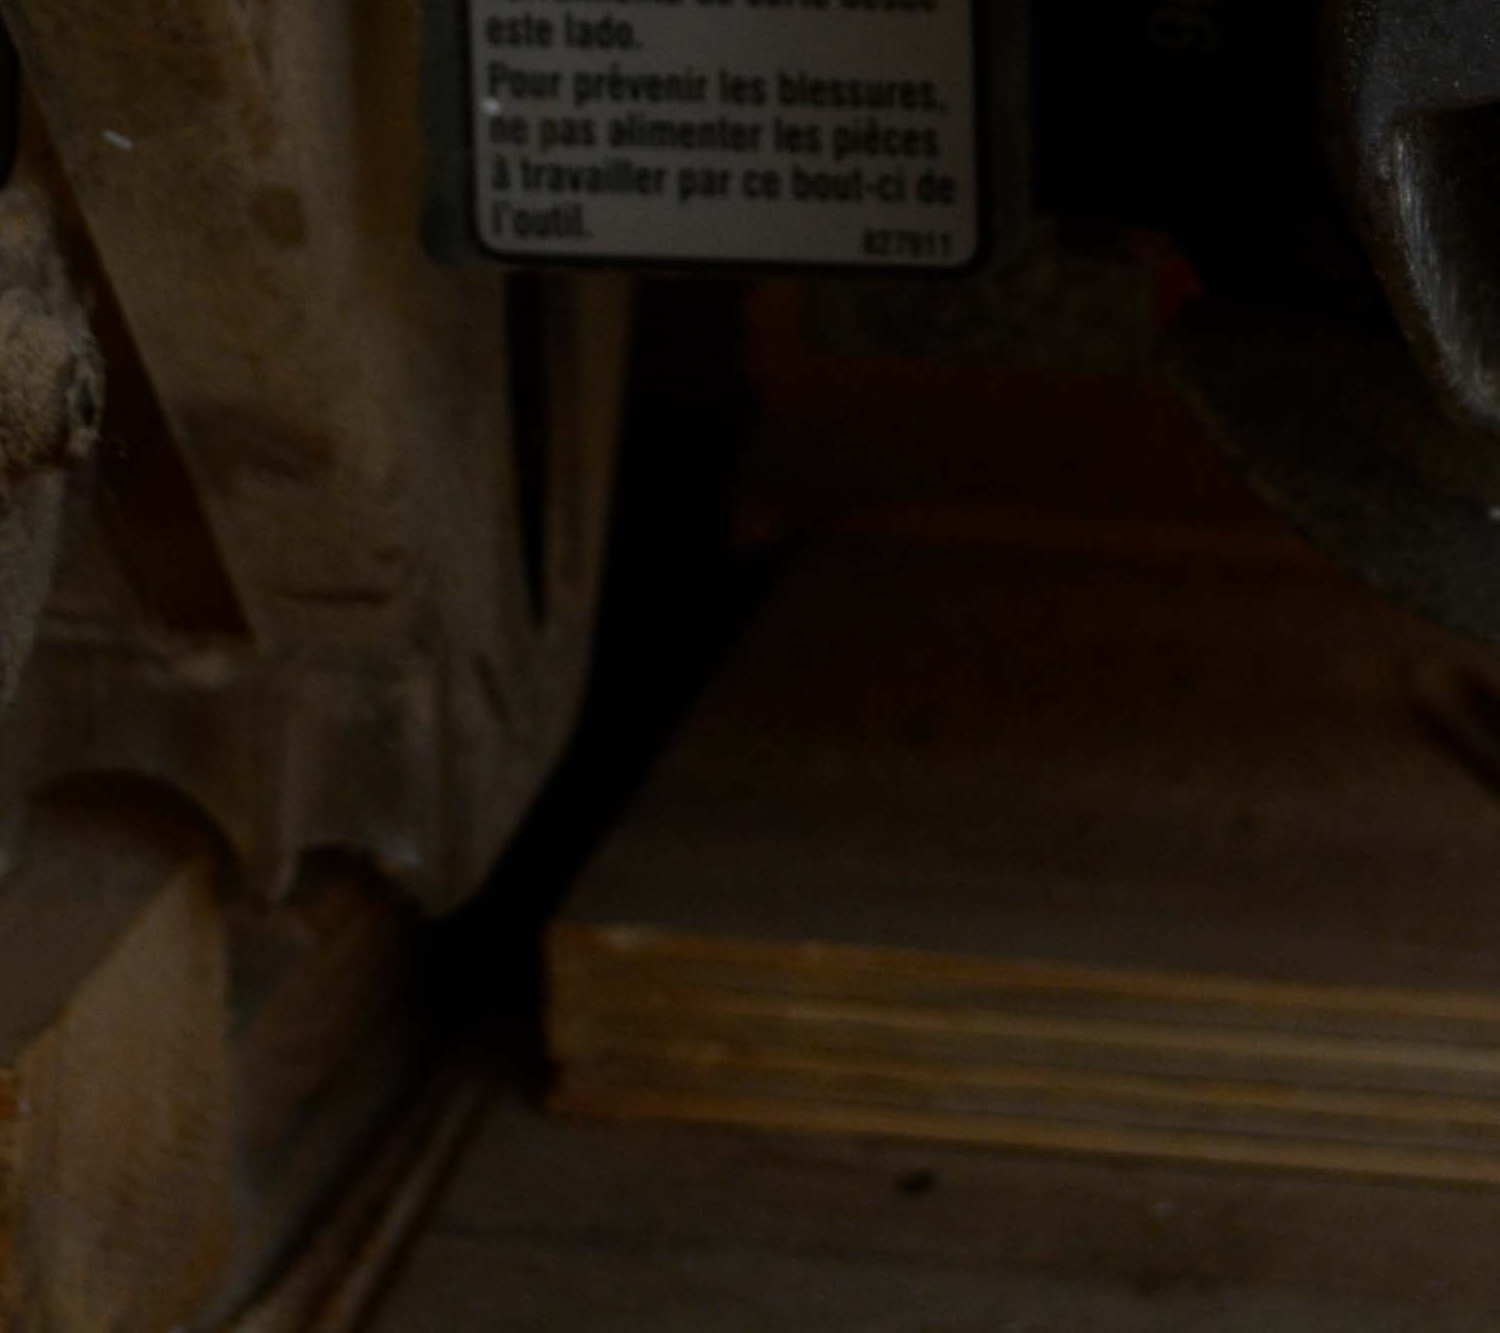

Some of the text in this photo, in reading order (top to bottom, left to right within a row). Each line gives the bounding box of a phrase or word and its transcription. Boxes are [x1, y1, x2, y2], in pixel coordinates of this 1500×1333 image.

[487, 13, 642, 49] este lado.
[488, 62, 947, 114] Pour prévenir les blessures,
[489, 114, 938, 161] ne pas alimenter les pièces
[521, 158, 664, 197] travailler
[678, 166, 728, 203] par
[743, 169, 780, 199] ce
[791, 165, 906, 202] bout-ci
[917, 168, 956, 203] de
